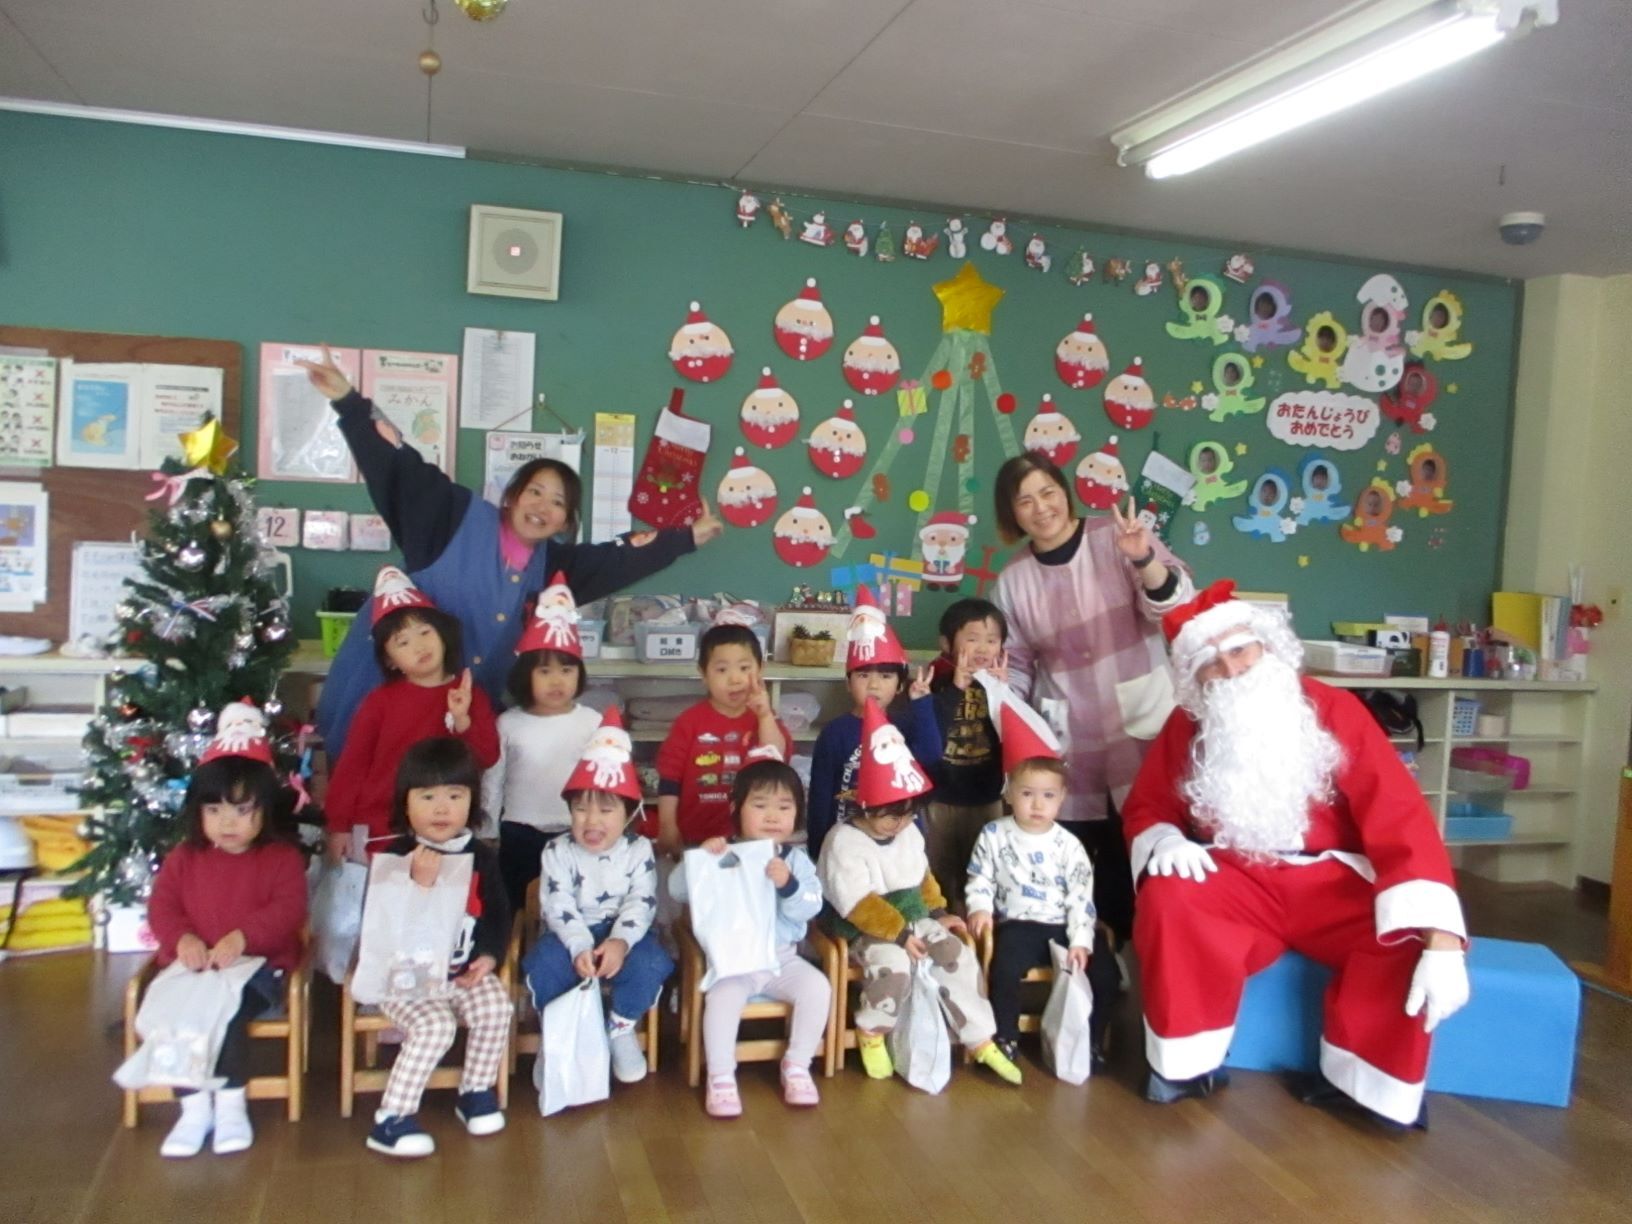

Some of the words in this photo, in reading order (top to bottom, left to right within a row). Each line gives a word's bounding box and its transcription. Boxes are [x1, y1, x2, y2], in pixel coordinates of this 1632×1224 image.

[388, 393, 432, 407] みかん
[1276, 402, 1370, 424] おたんじょうび
[1290, 421, 1354, 439] おめでとう
[265, 516, 287, 538] 12
